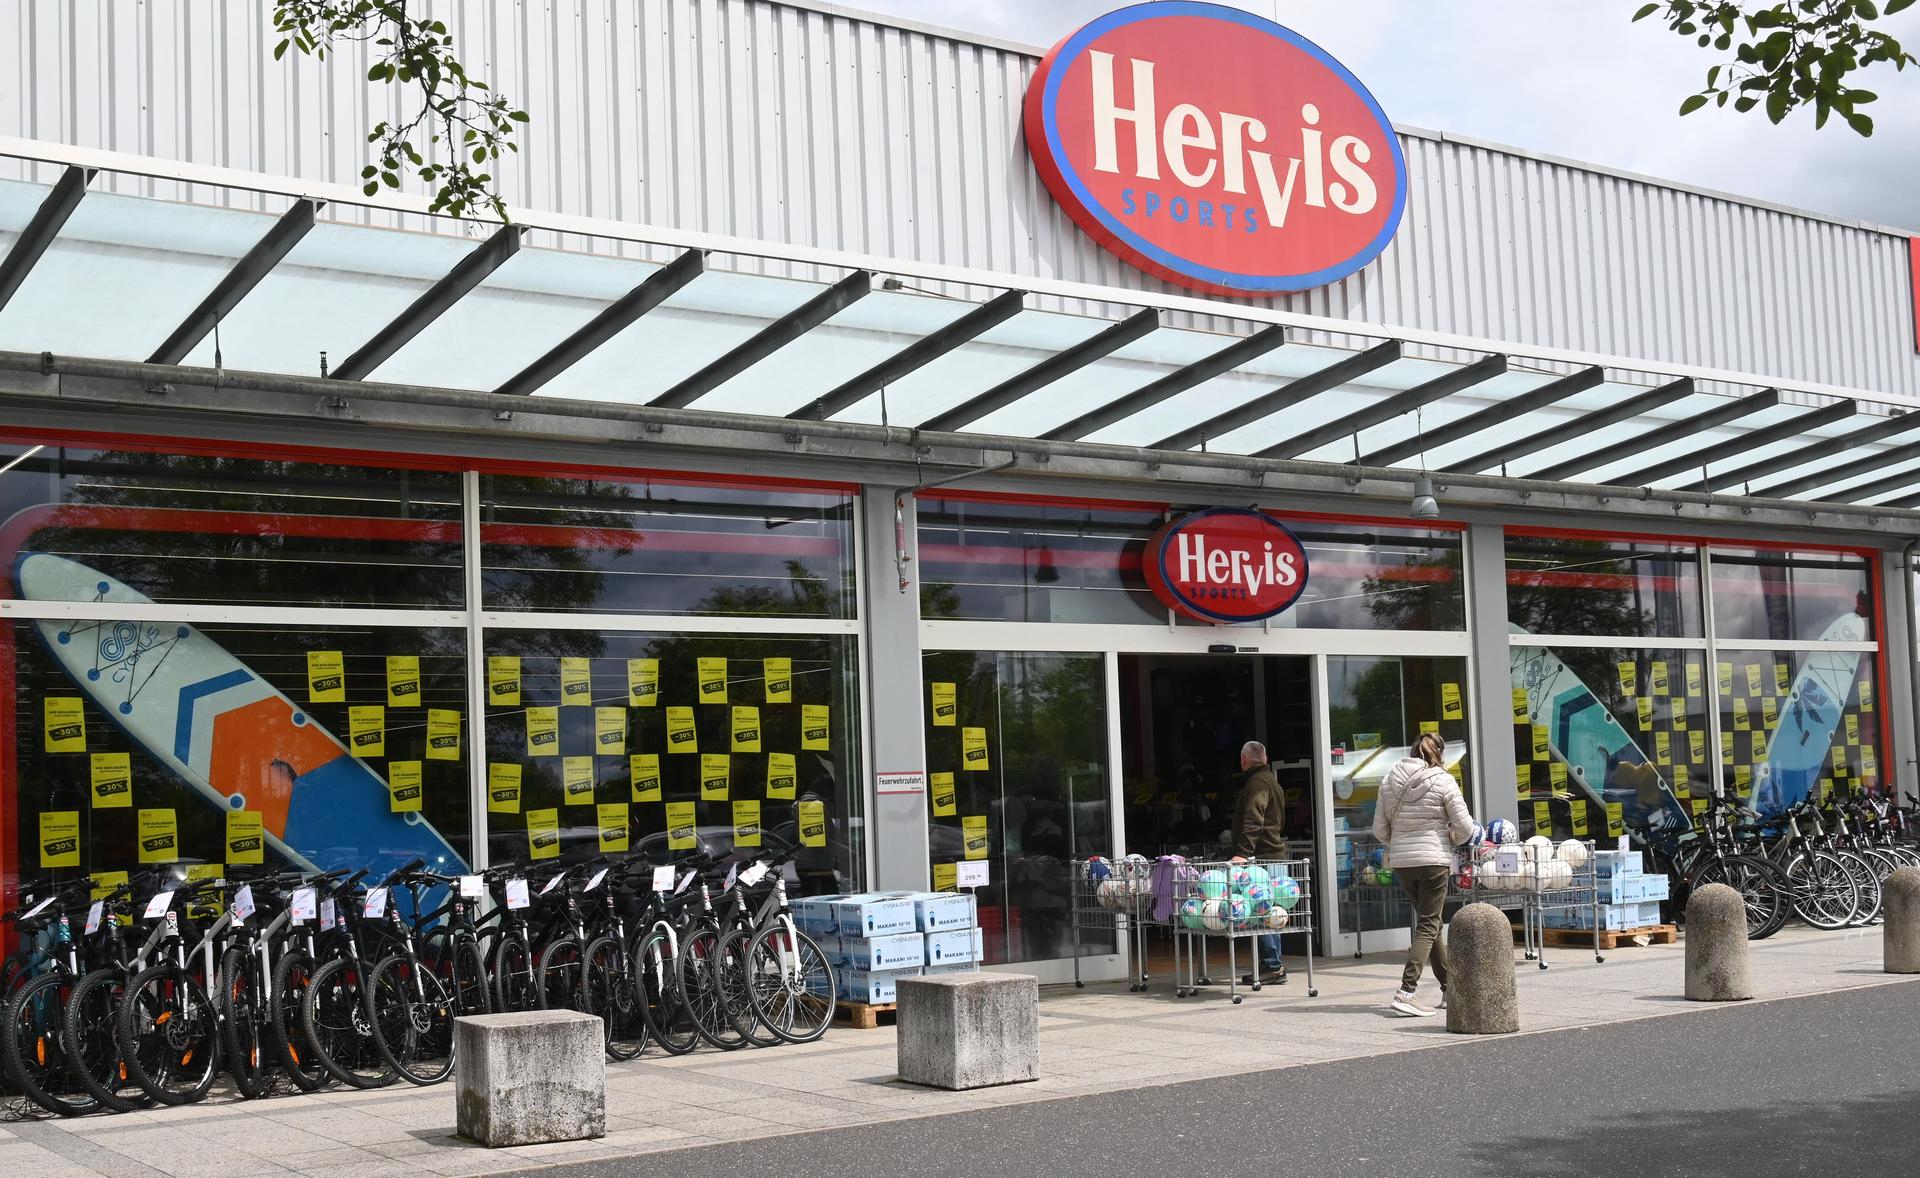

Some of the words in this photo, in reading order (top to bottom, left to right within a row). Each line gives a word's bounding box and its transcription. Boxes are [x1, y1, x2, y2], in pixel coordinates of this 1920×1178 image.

[1089, 49, 1378, 229] Hervis
[1121, 188, 1258, 234] SPORTS
[1178, 533, 1297, 596] Hervis
[1190, 587, 1247, 600] SPORTS
[879, 776, 922, 786] Feuerwehrzufahrt
